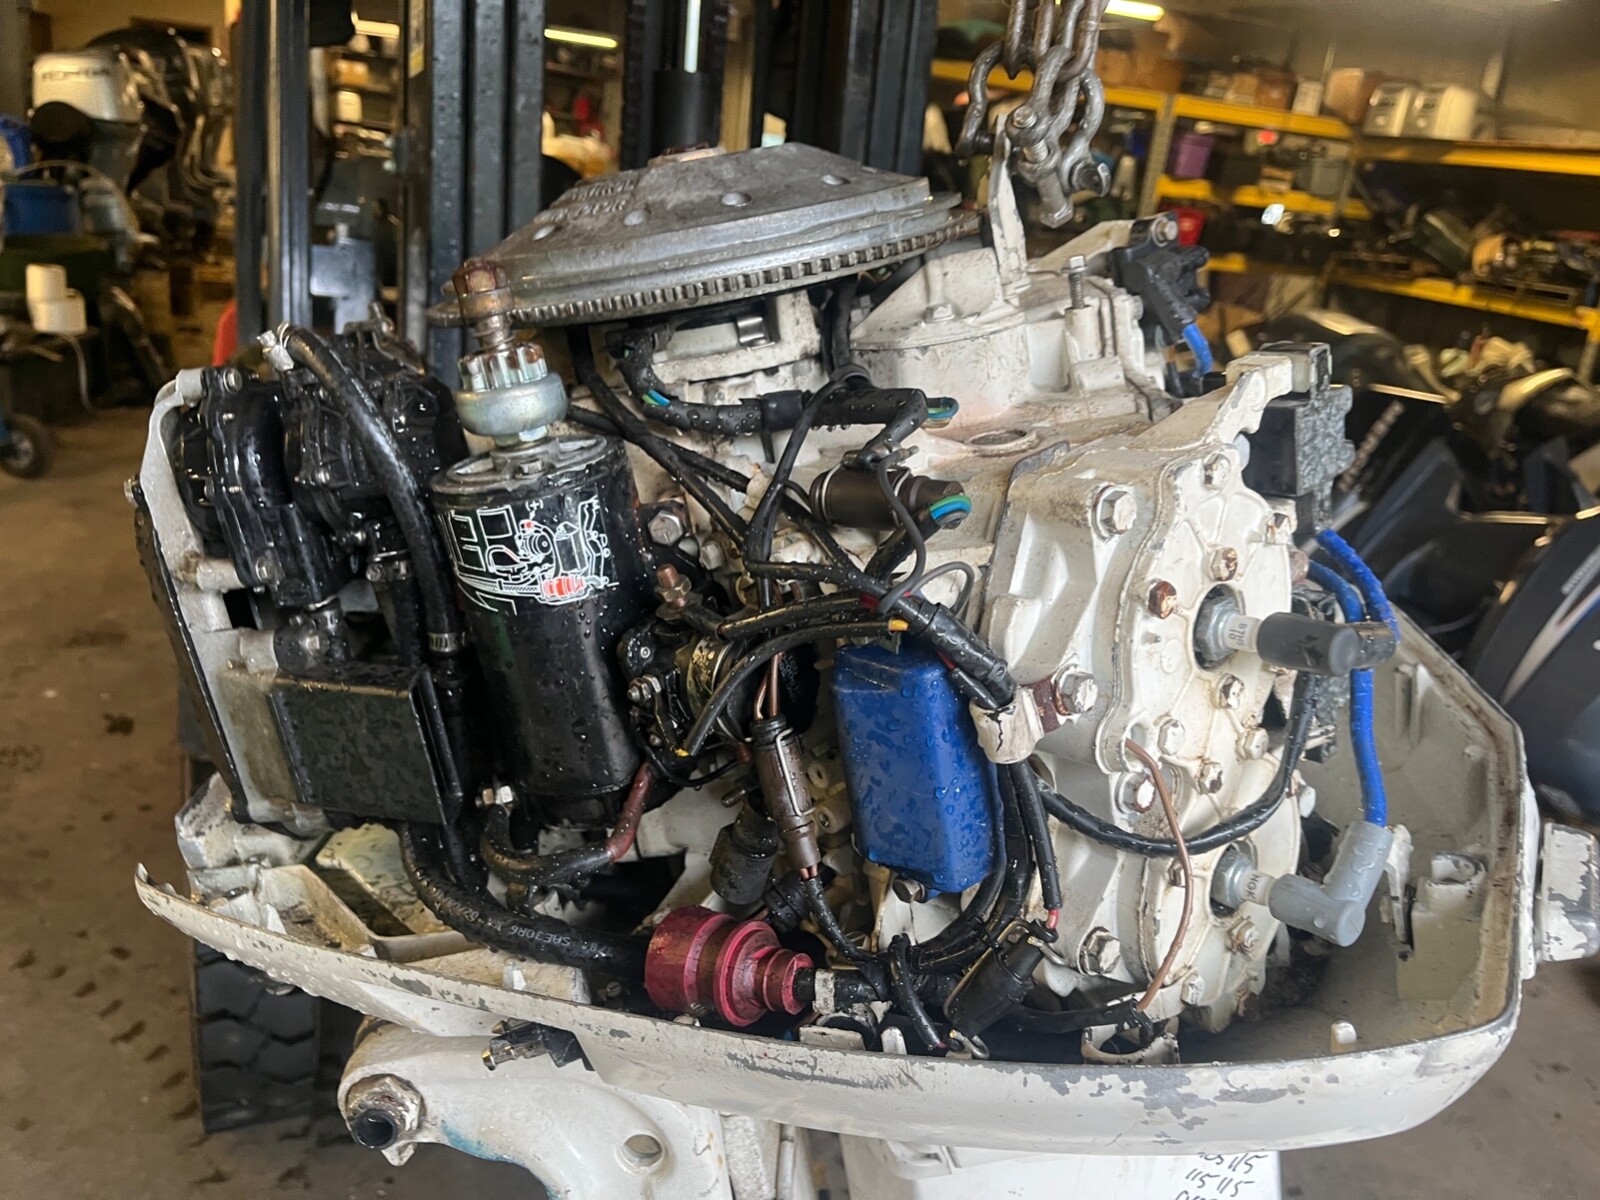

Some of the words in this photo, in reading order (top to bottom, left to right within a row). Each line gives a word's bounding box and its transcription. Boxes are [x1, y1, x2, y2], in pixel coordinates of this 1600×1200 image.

[1246, 873, 1260, 899] NGK
[510, 925, 571, 946] SAE30R6
[1185, 1168, 1221, 1188] 115
[1216, 1177, 1255, 1197] 115
